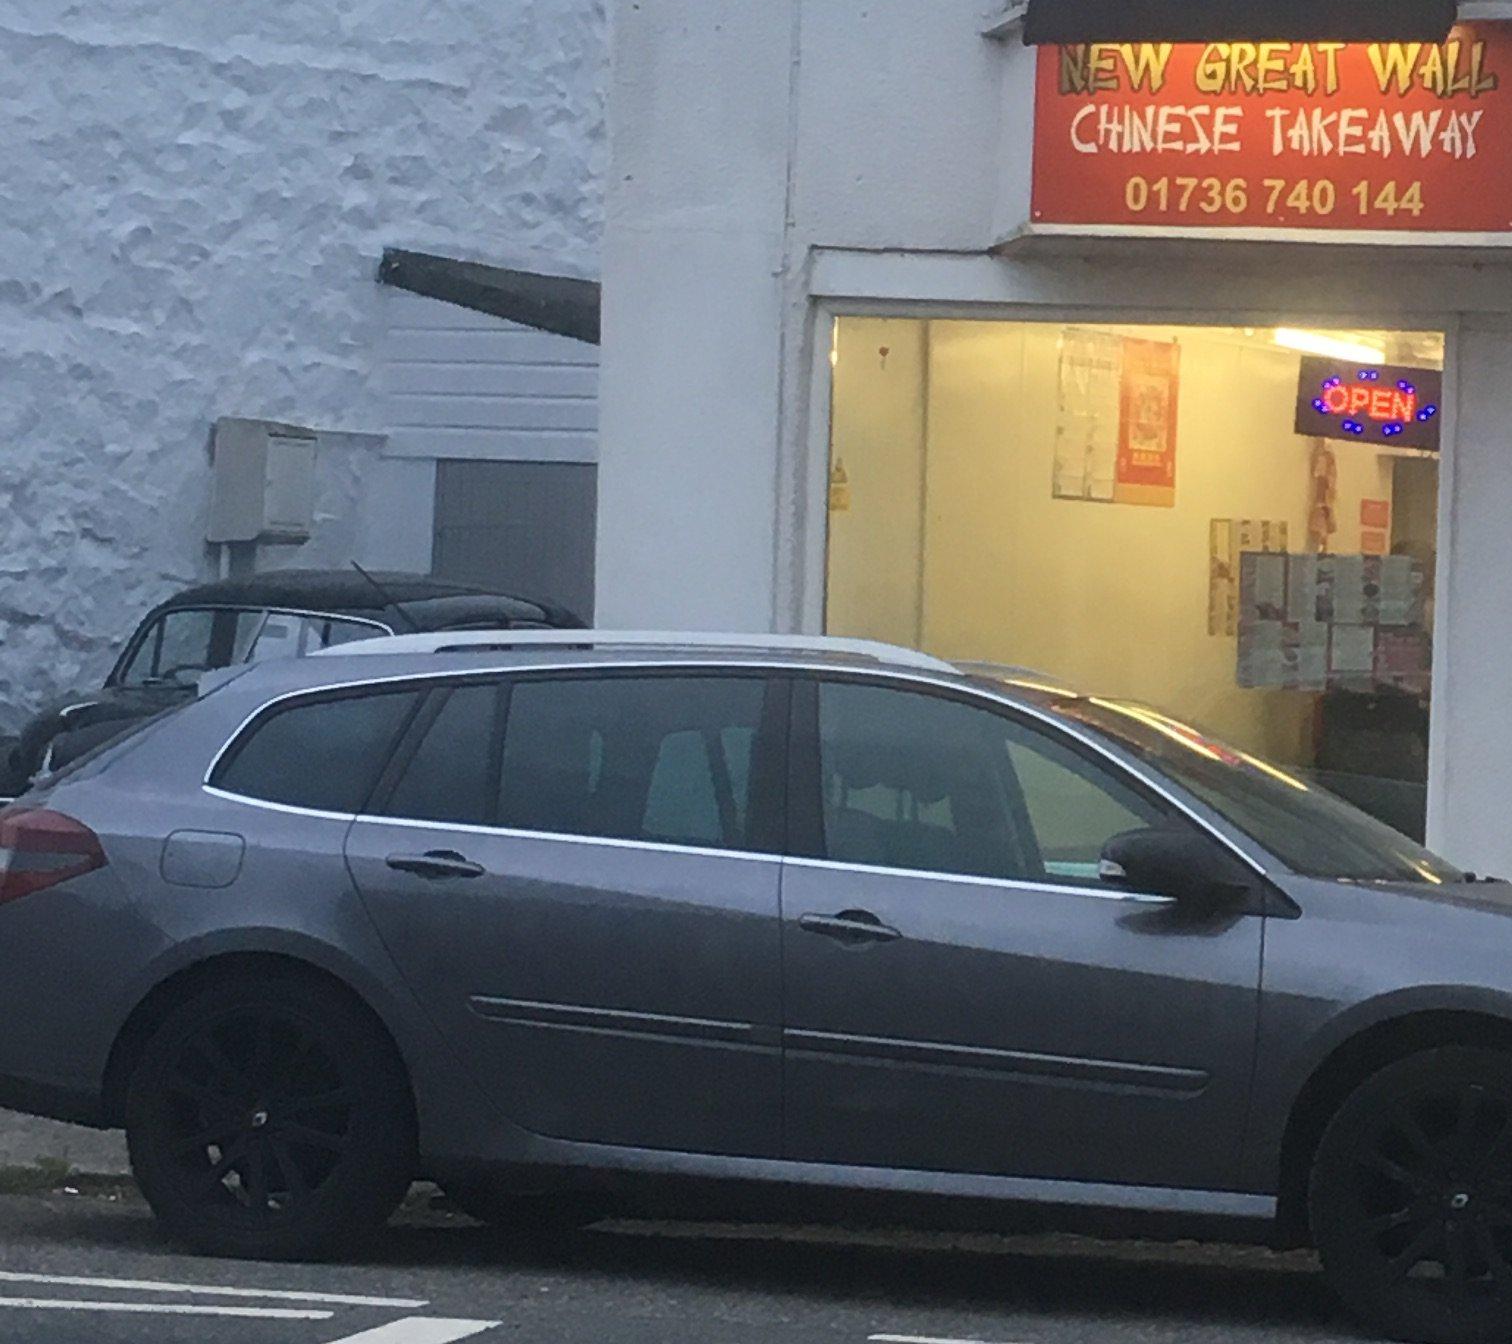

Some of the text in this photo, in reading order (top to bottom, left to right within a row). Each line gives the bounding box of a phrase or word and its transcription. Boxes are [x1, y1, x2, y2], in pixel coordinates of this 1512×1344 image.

[1060, 42, 1497, 97] NEW GREAT WALL
[1070, 103, 1484, 159] CHINESE TAKEAWAY
[1125, 176, 1424, 216] 01736 740 144
[1323, 385, 1417, 423] OPEN
